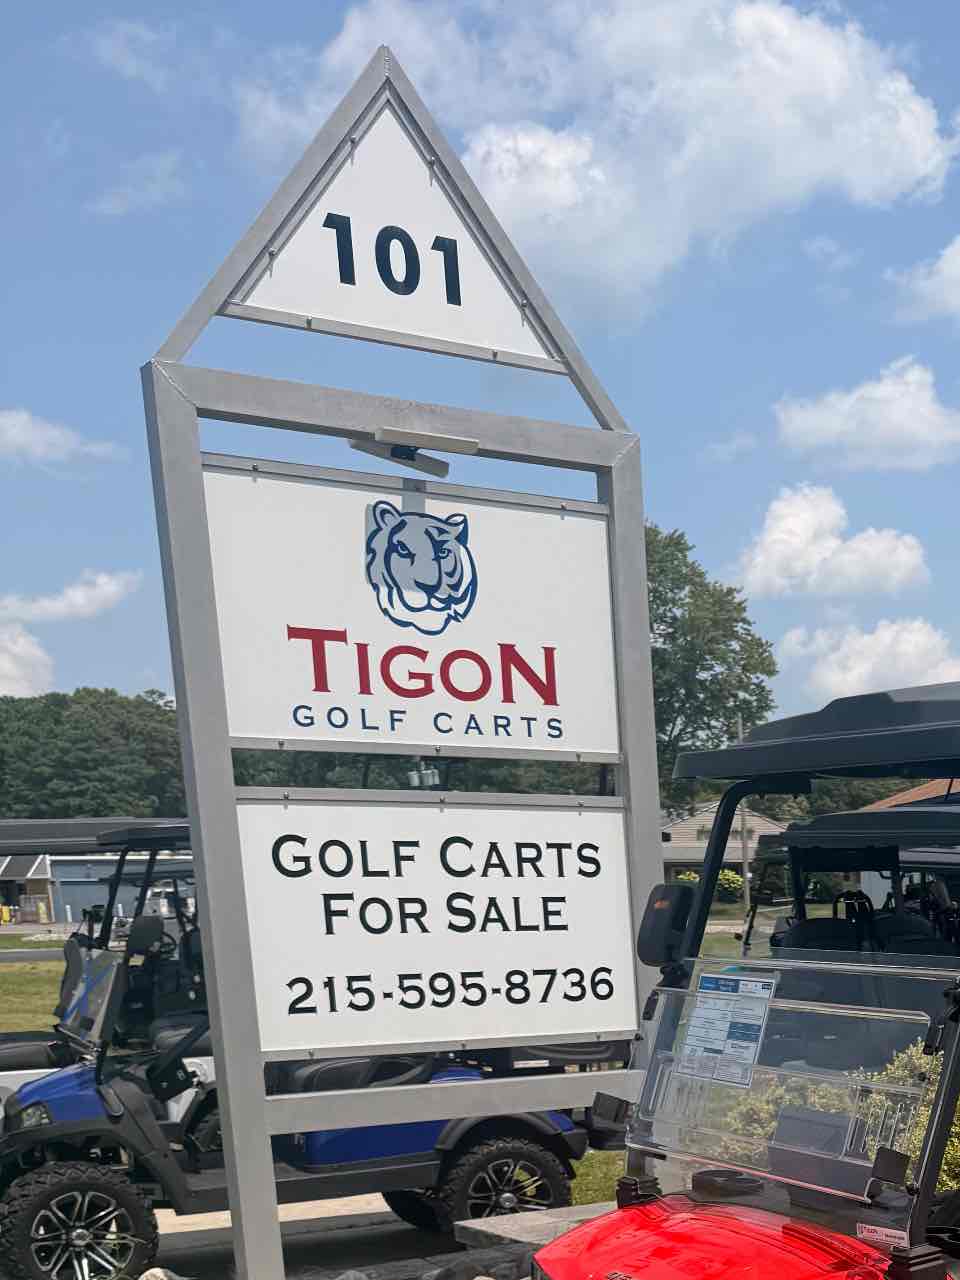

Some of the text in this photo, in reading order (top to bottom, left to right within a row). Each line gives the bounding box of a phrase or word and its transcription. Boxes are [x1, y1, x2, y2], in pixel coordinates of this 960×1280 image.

[321, 212, 462, 307] 101
[286, 623, 561, 707] TIGON
[292, 704, 564, 739] GOLF CARTS
[271, 833, 602, 879] GOLF CARTS
[320, 891, 569, 936] FOR SALE
[285, 966, 614, 1016] 215-595-8736
